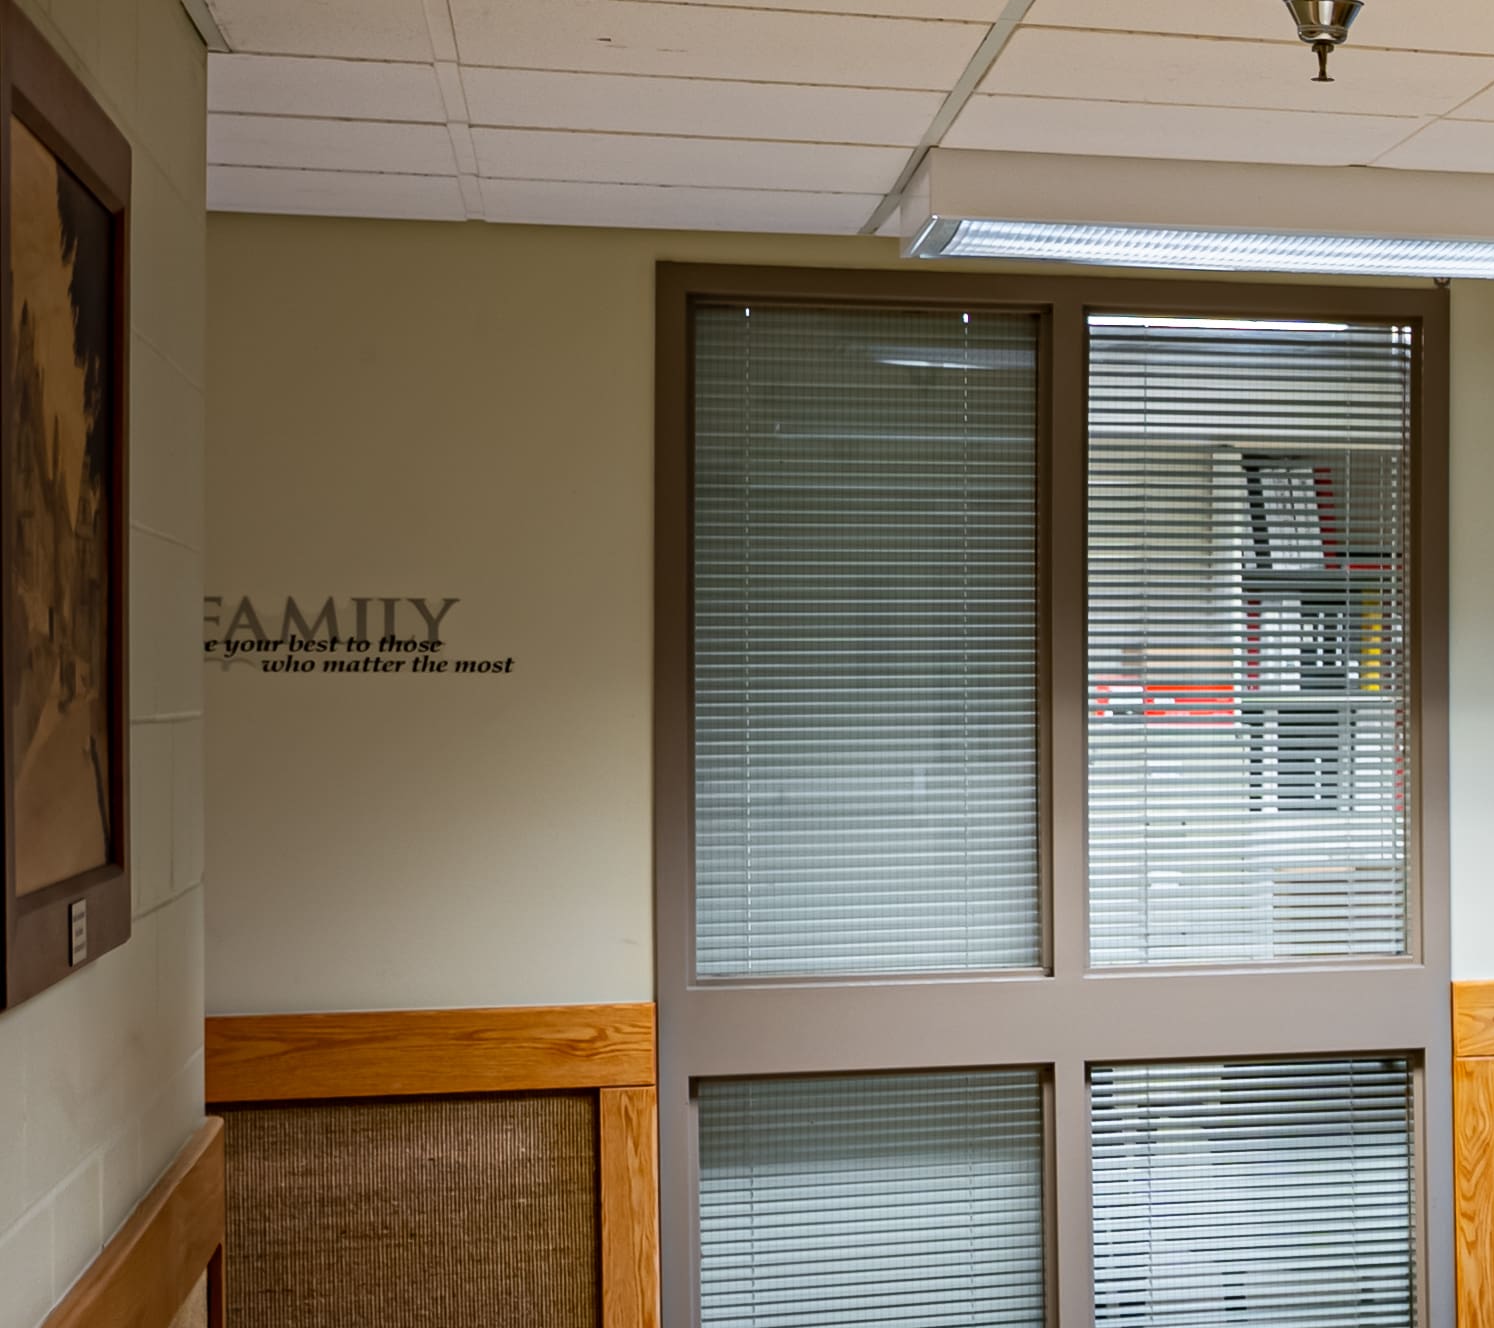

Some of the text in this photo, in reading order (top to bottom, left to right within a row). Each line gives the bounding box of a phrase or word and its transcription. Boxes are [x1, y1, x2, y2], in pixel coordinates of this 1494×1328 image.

[224, 639, 284, 658] your
[289, 634, 337, 652] best
[346, 636, 370, 652] to
[379, 634, 442, 652] those
[261, 655, 515, 673] who matter the most
